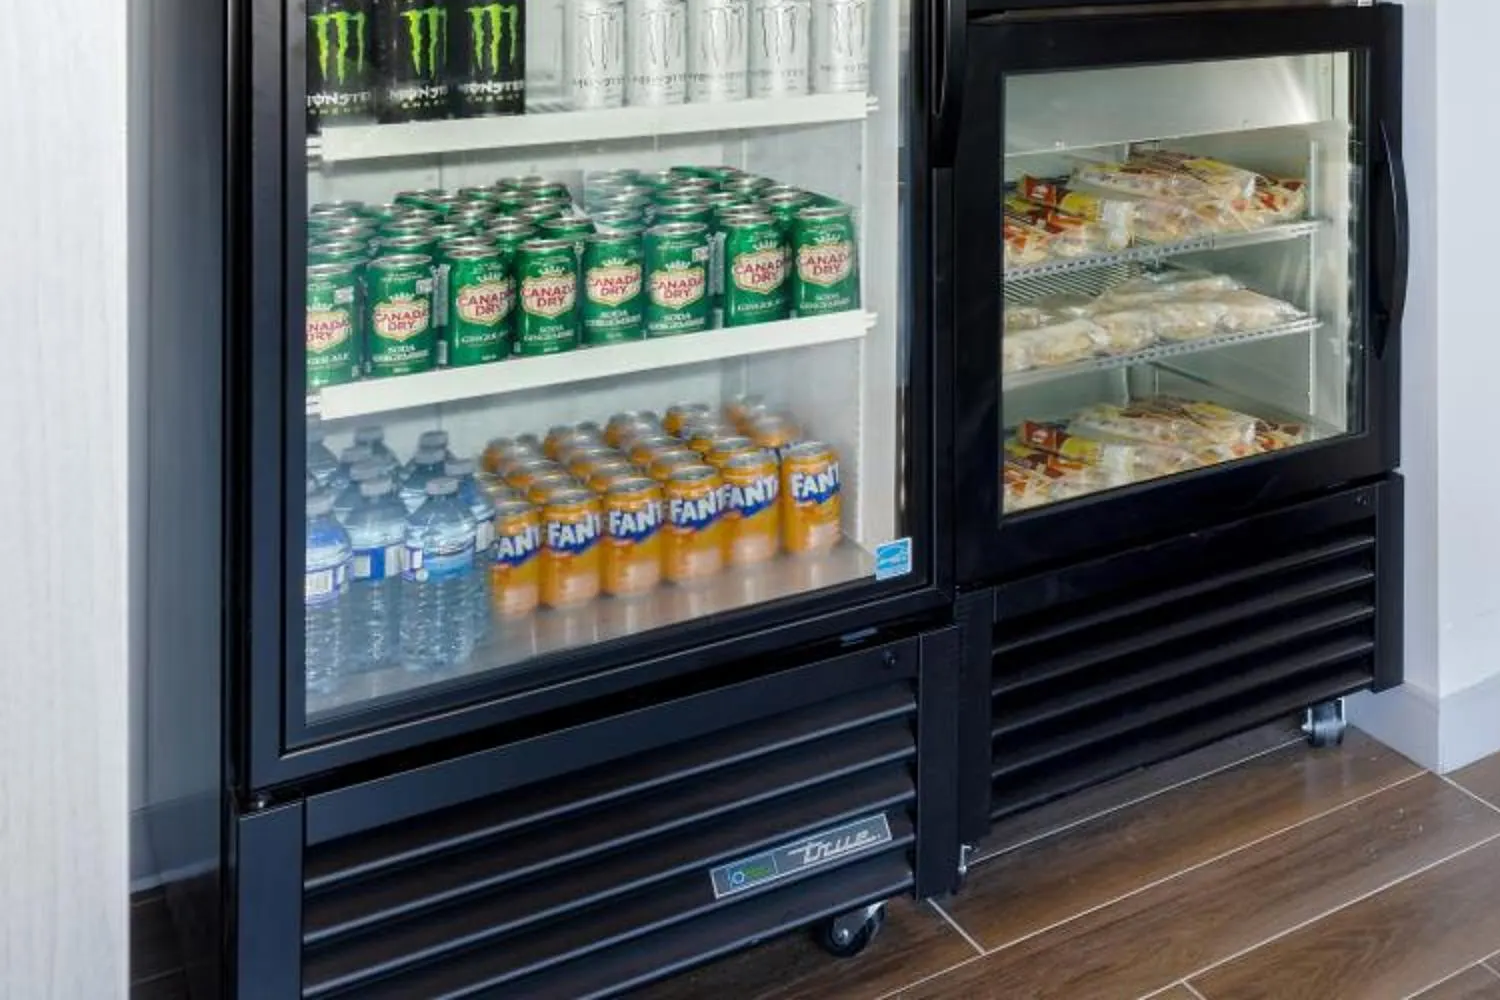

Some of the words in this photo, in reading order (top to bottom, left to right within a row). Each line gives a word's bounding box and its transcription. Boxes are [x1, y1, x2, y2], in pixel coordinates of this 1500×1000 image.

[813, 263, 841, 276] DRY
[664, 288, 690, 299] DRY
[537, 296, 565, 308] DRY
[307, 320, 349, 331] NADA
[388, 320, 414, 331] DRY
[497, 526, 541, 562] ANT
[787, 829, 880, 865] True
